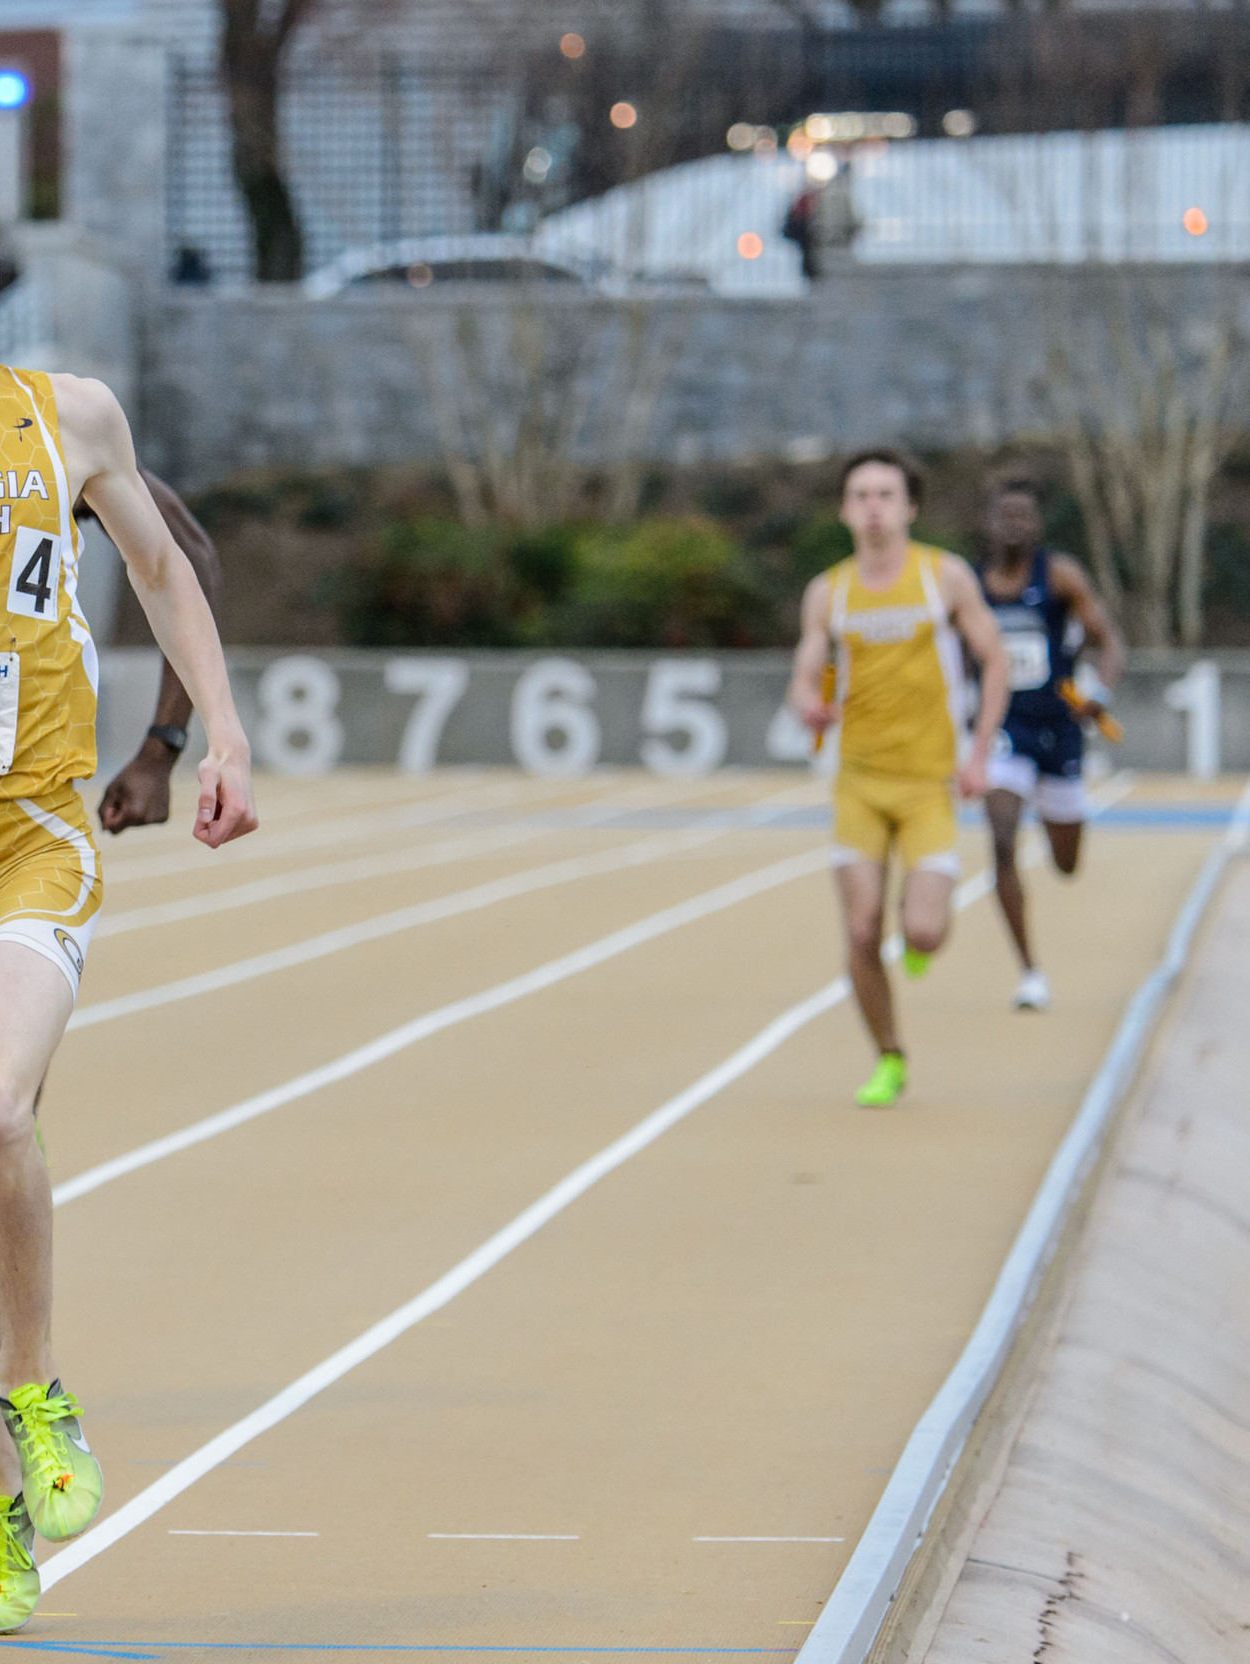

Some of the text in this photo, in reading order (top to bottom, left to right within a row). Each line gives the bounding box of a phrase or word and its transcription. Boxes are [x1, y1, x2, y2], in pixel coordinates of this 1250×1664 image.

[16, 538, 53, 613] 4
[254, 655, 345, 777] 8
[383, 658, 470, 778] 7
[510, 656, 602, 778] 6
[640, 658, 728, 778] 5
[1165, 659, 1221, 783] 1
